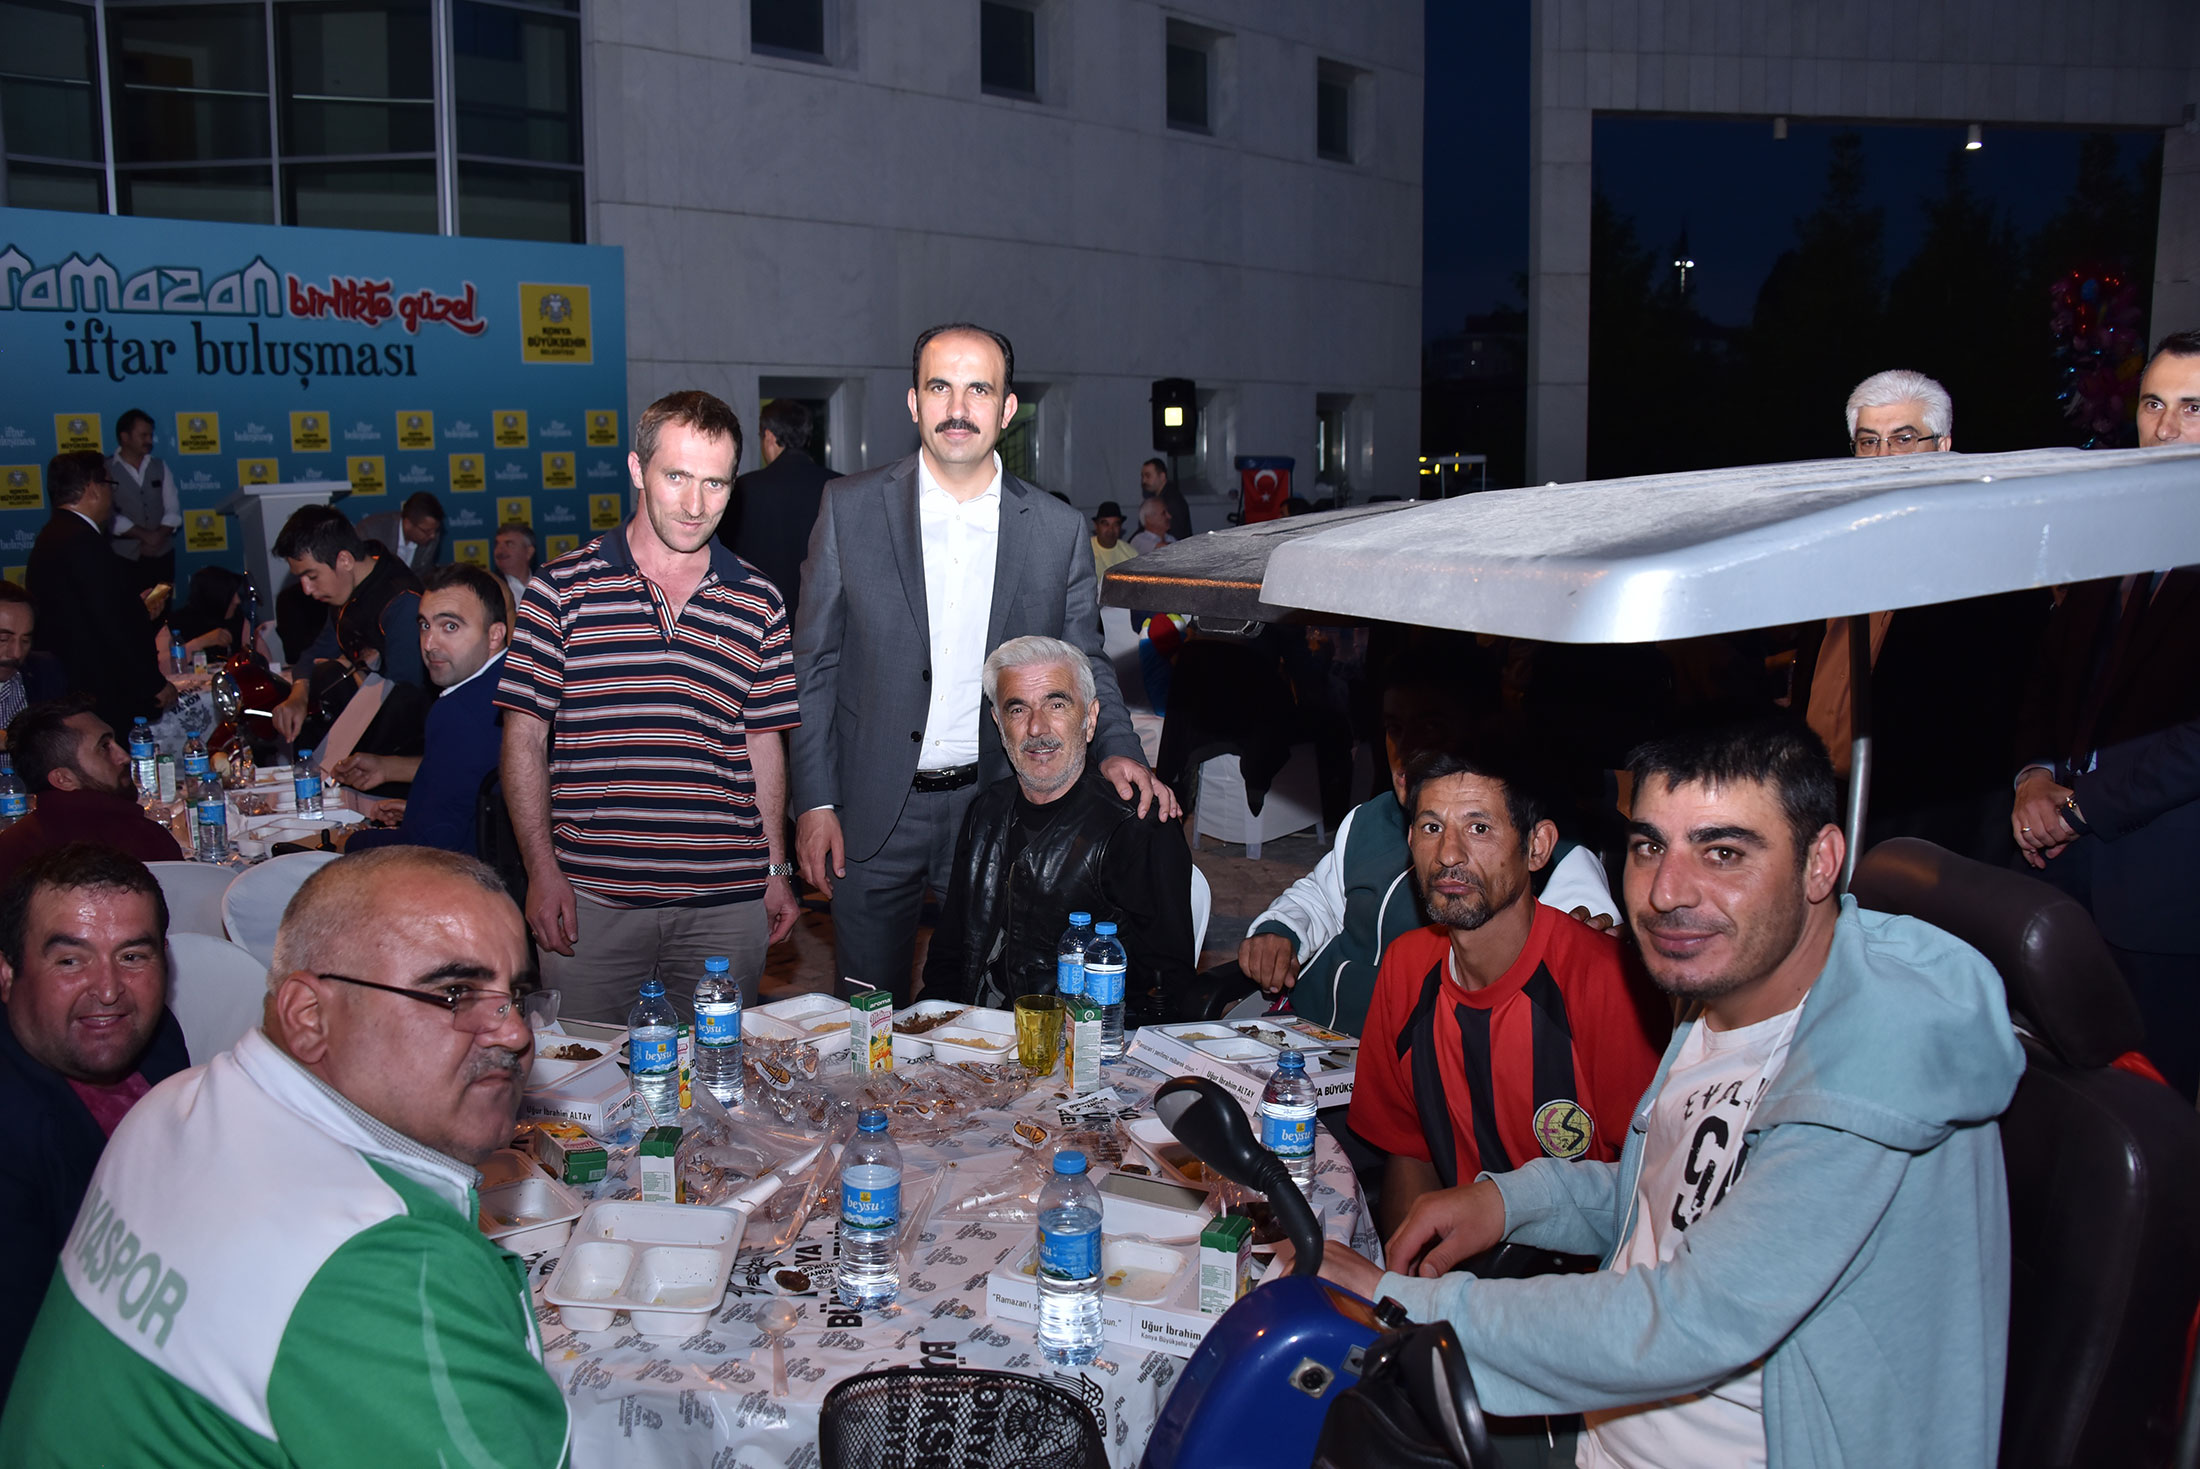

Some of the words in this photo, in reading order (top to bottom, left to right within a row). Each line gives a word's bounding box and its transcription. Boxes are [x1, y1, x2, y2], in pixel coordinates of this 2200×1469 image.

[399, 281, 488, 335] güzel
[542, 327, 571, 335] KONYA
[64, 319, 176, 382] iftar
[191, 321, 417, 390] buluşması
[870, 998, 891, 1008] aroma
[698, 1020, 722, 1034] beysu
[645, 1050, 672, 1062] beysu
[1237, 1085, 1256, 1099] ALTAY
[526, 1105, 543, 1117] Uğur
[569, 1111, 592, 1121] ALTAY
[1281, 1129, 1311, 1143] beysu
[847, 1195, 880, 1213] beysu
[1103, 1319, 1122, 1328] sun."
[1141, 1319, 1163, 1335] Uğur
[1165, 1322, 1202, 1341] İbrahim
[1141, 1332, 1157, 1342] Konya
